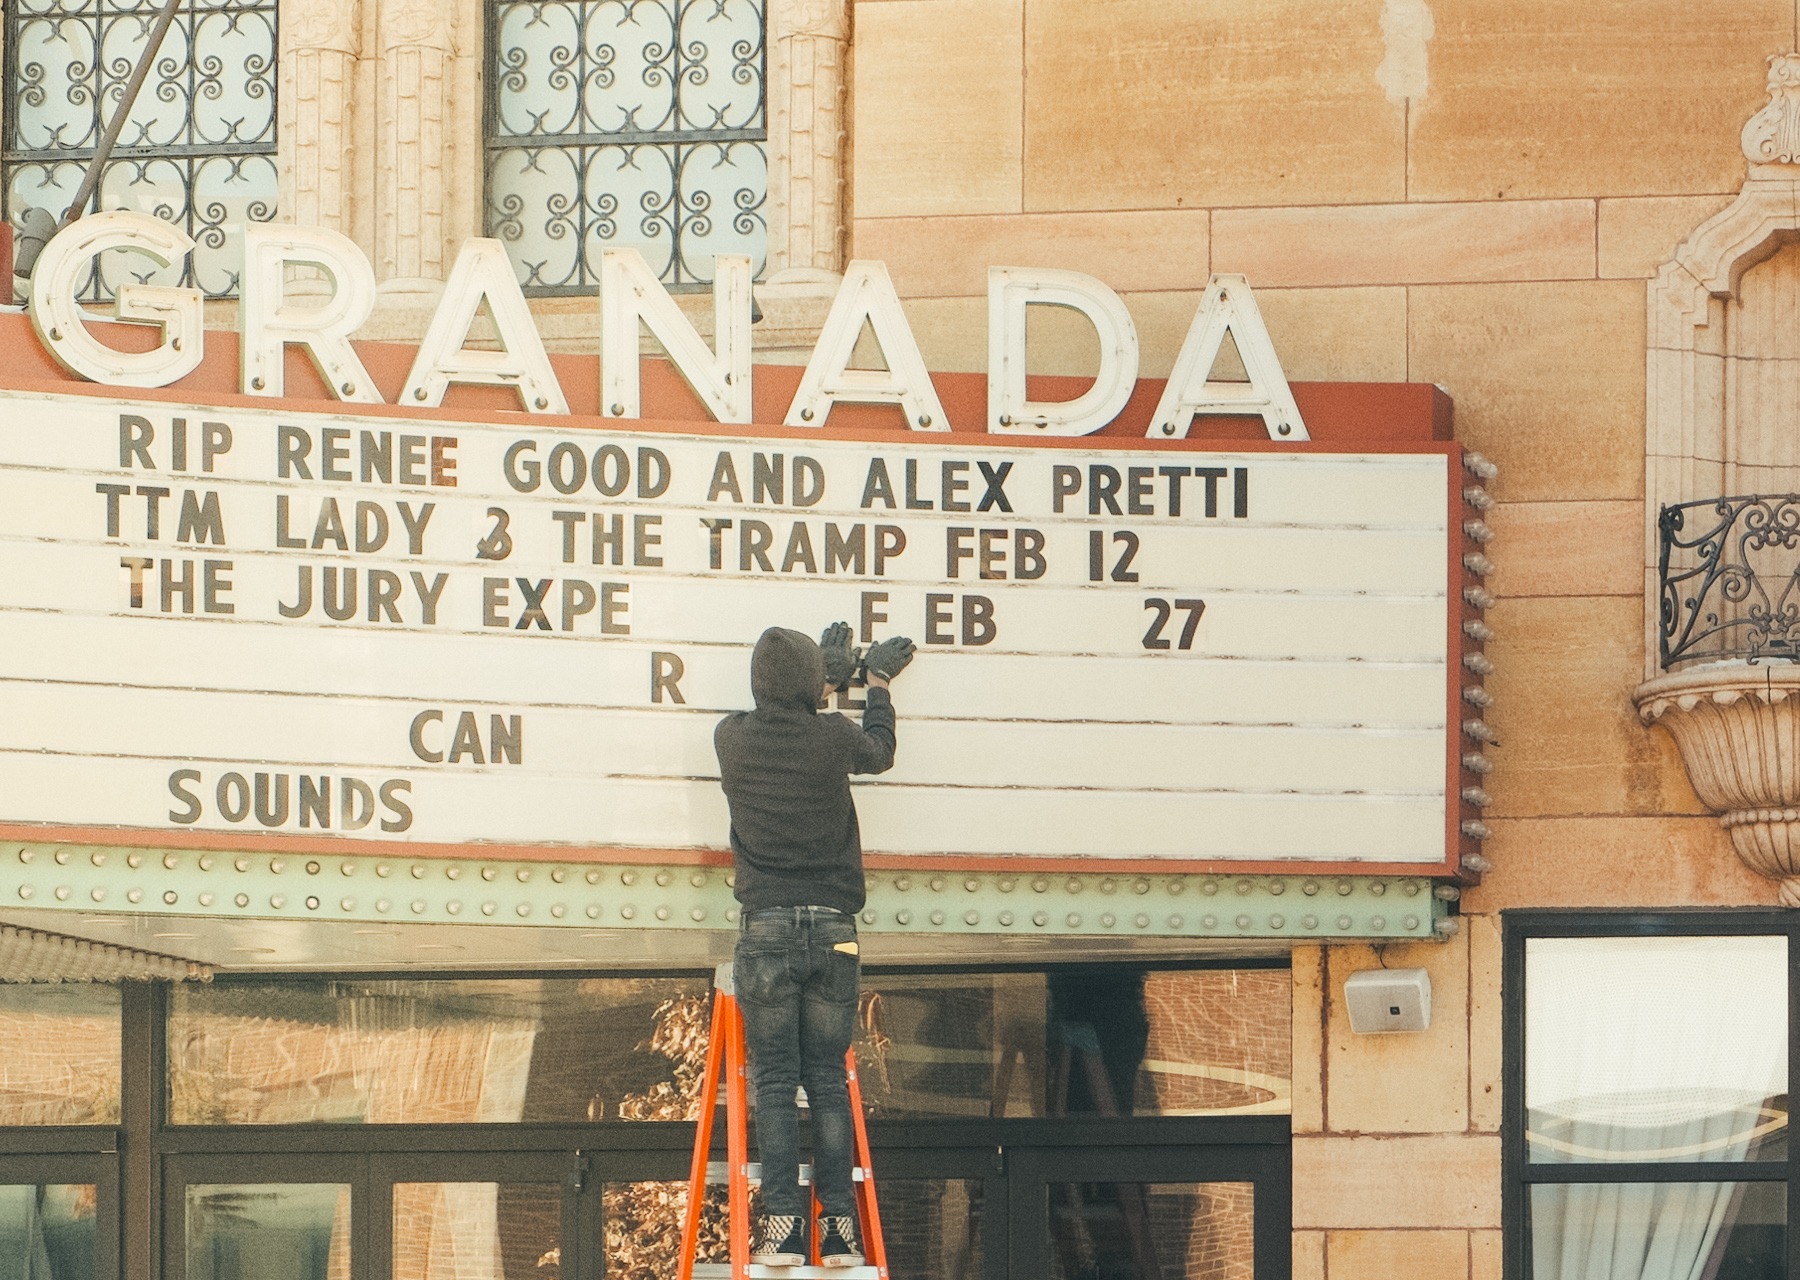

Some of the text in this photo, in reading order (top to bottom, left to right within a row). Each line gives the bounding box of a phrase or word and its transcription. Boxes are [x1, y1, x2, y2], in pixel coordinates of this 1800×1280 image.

[30, 211, 1311, 442] GRANADA
[119, 414, 1249, 519] RIP RENEE GOOD AND ALEX PRETTI
[96, 483, 226, 546] TTM
[276, 495, 436, 556] LADY
[552, 511, 664, 568] THE
[699, 517, 907, 577] TRAMP
[946, 526, 1047, 581] FEB
[1089, 530, 1140, 583] 12
[120, 557, 235, 615] THE
[278, 565, 450, 625] JURY
[482, 576, 631, 635] EXPE
[1142, 598, 1206, 651] 27
[650, 651, 686, 705] R
[409, 709, 522, 765] CAN
[168, 768, 413, 833] SOUNDS
